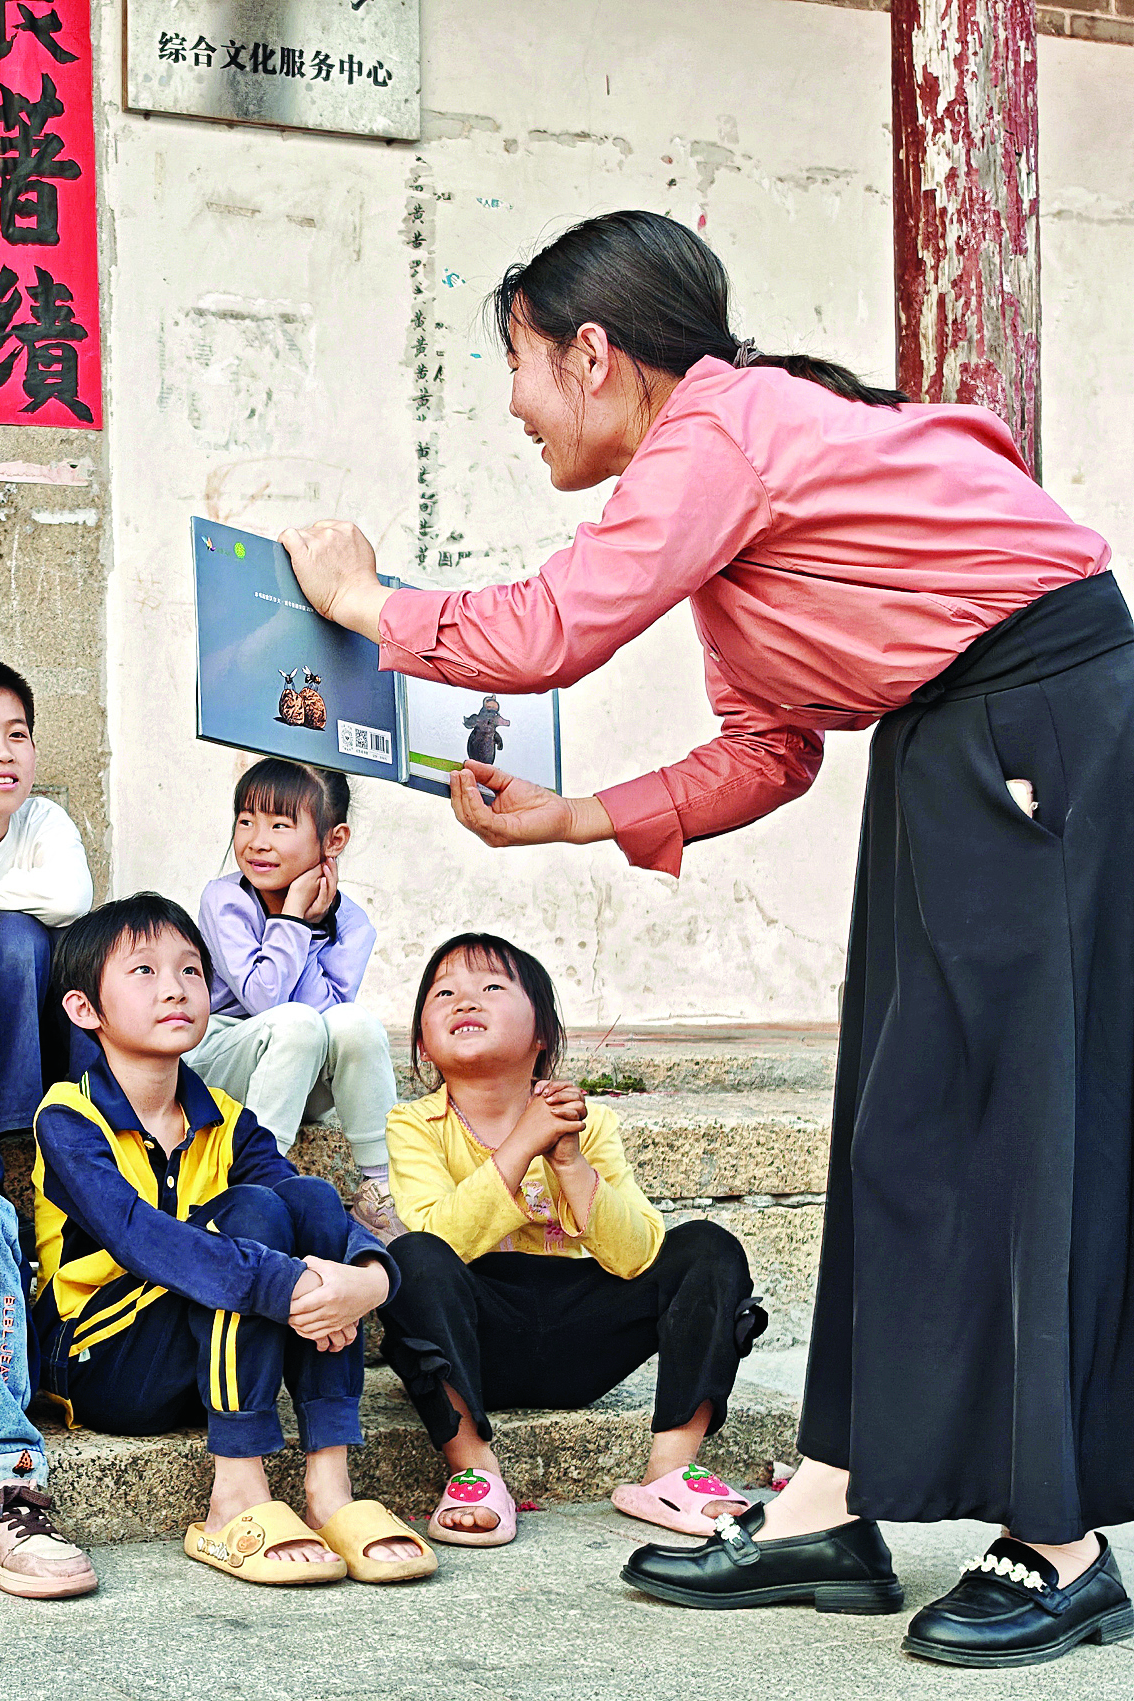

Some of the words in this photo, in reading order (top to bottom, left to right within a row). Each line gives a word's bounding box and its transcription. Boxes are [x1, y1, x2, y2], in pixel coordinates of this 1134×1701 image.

[157, 31, 393, 88] 综合文化服务中心
